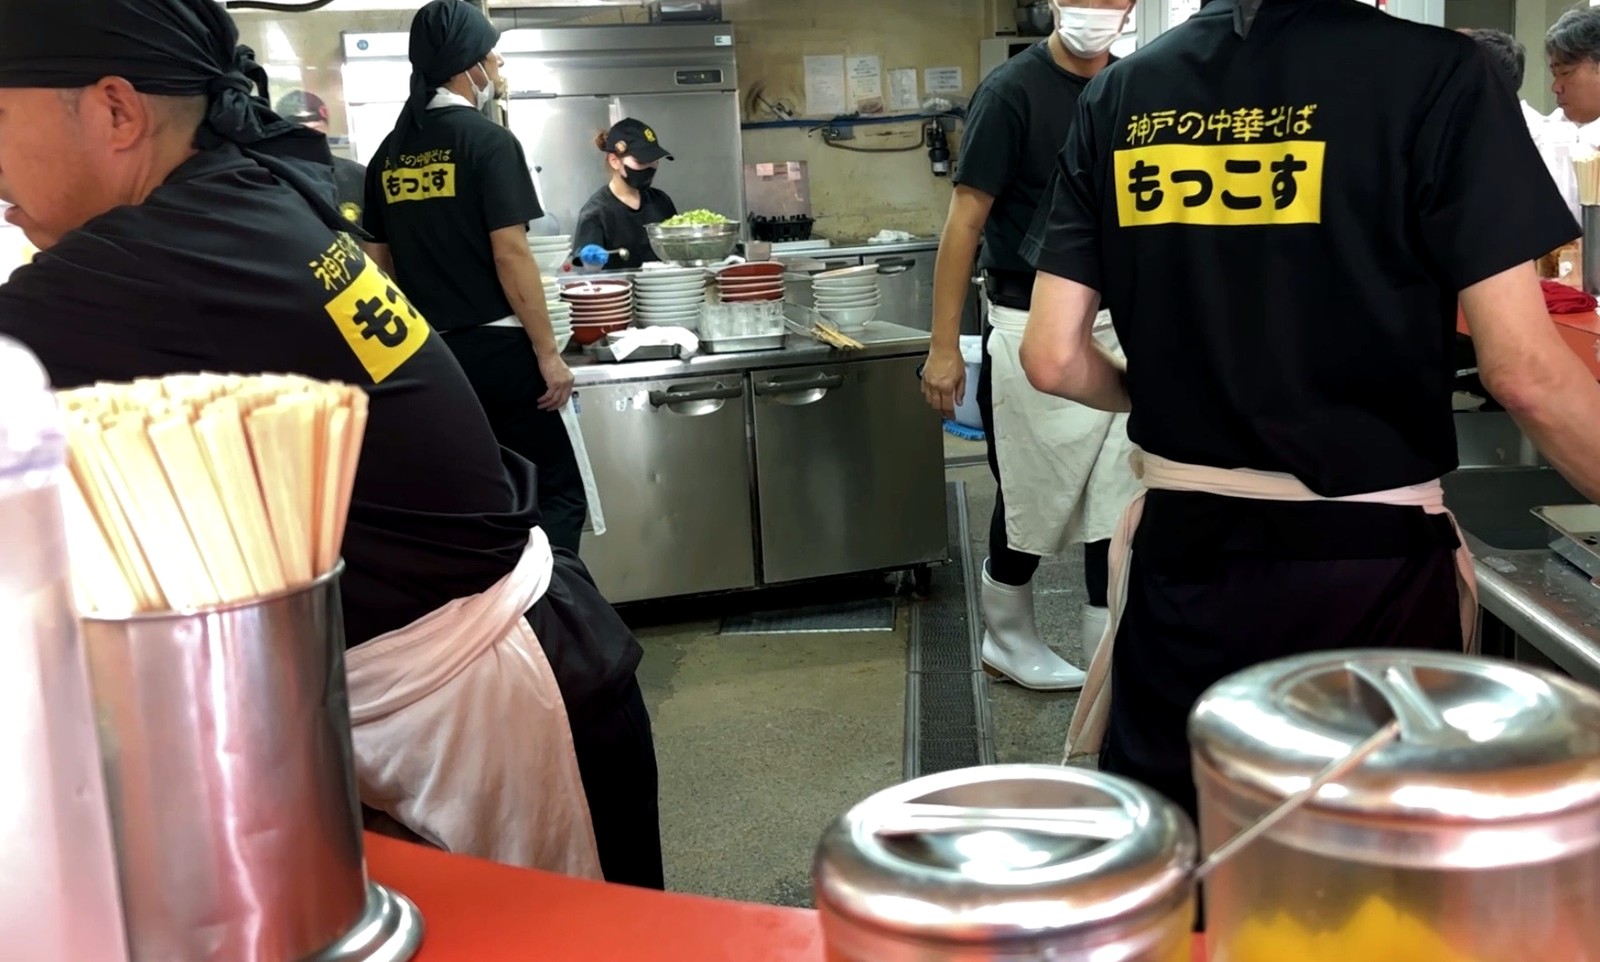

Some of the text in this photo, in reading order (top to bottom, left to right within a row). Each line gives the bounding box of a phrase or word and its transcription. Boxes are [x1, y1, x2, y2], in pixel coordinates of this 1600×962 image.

[1126, 104, 1317, 145] 神戸の中華そば
